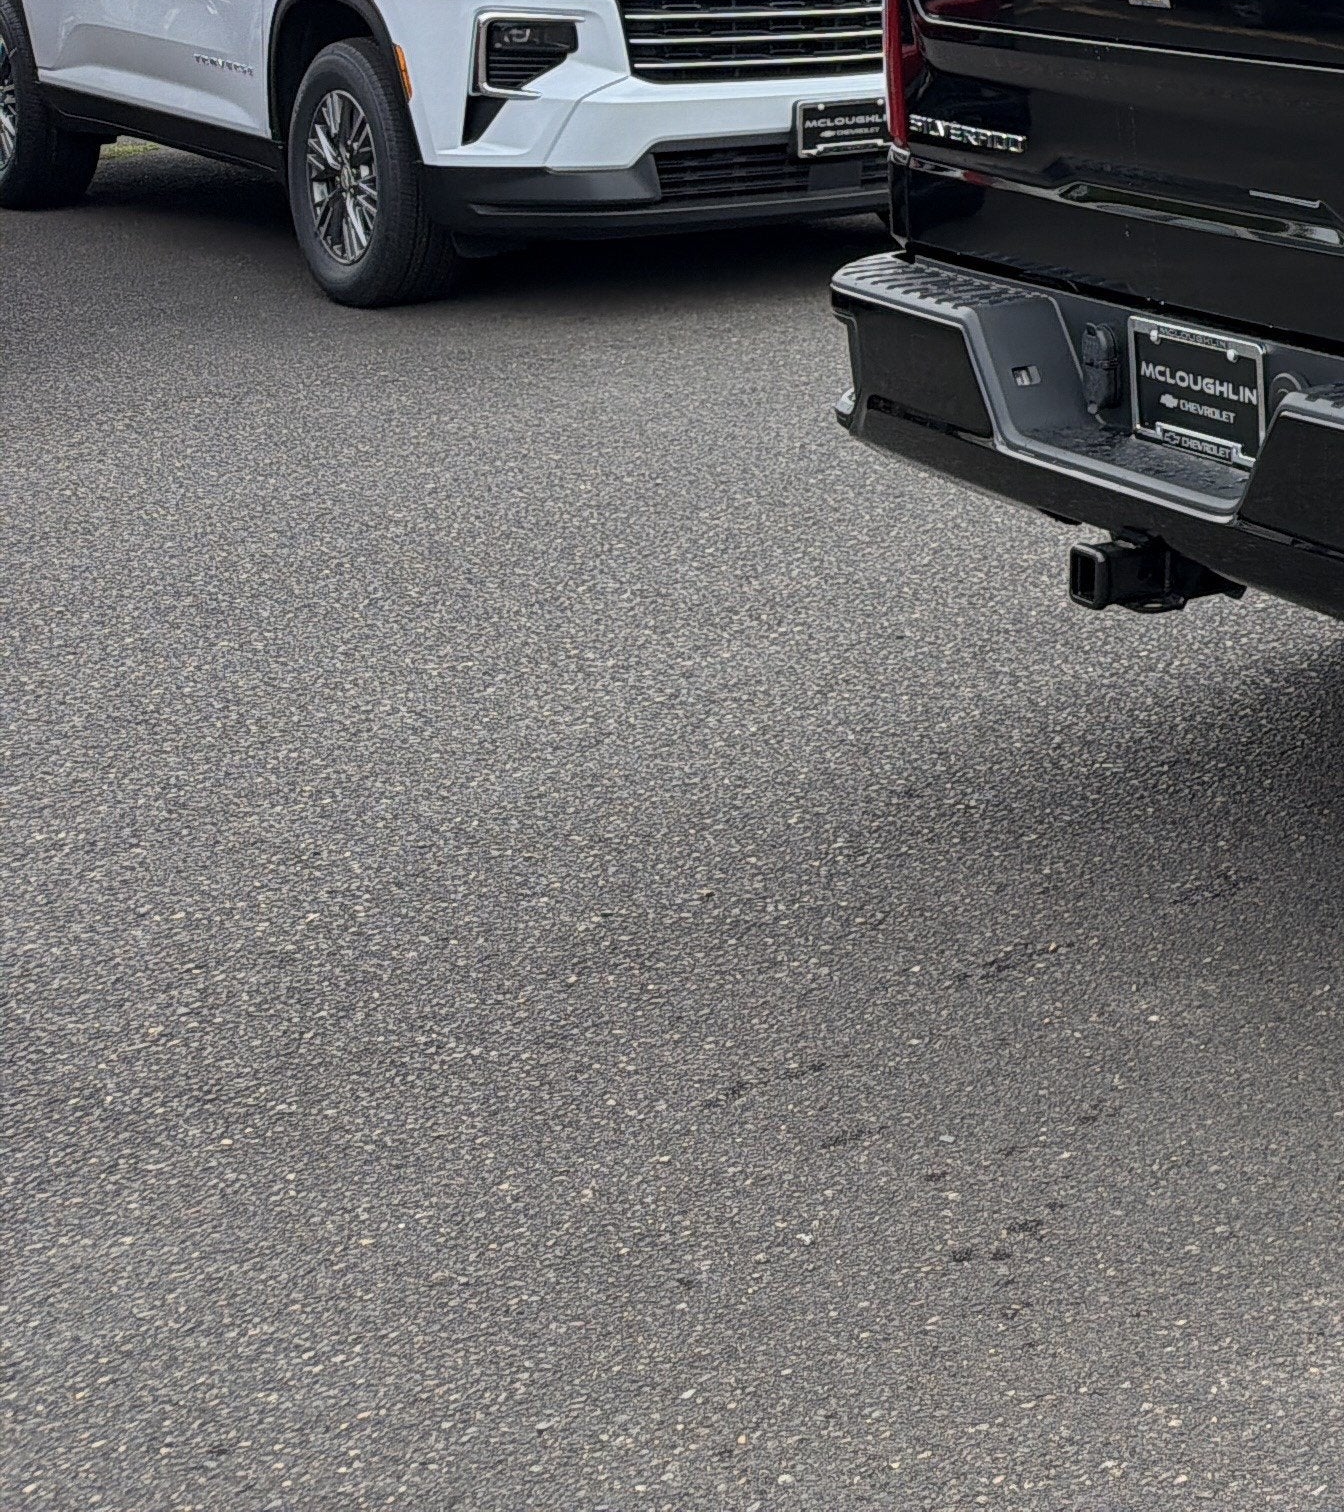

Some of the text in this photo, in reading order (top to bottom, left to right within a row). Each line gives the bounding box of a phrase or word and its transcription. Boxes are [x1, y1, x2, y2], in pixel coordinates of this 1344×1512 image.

[804, 113, 887, 129] MCLOUGHLI
[1140, 360, 1258, 406] MCLOUGHLIN
[1179, 398, 1236, 424] CHEVROLET
[1181, 437, 1232, 459] CHEVROLET
